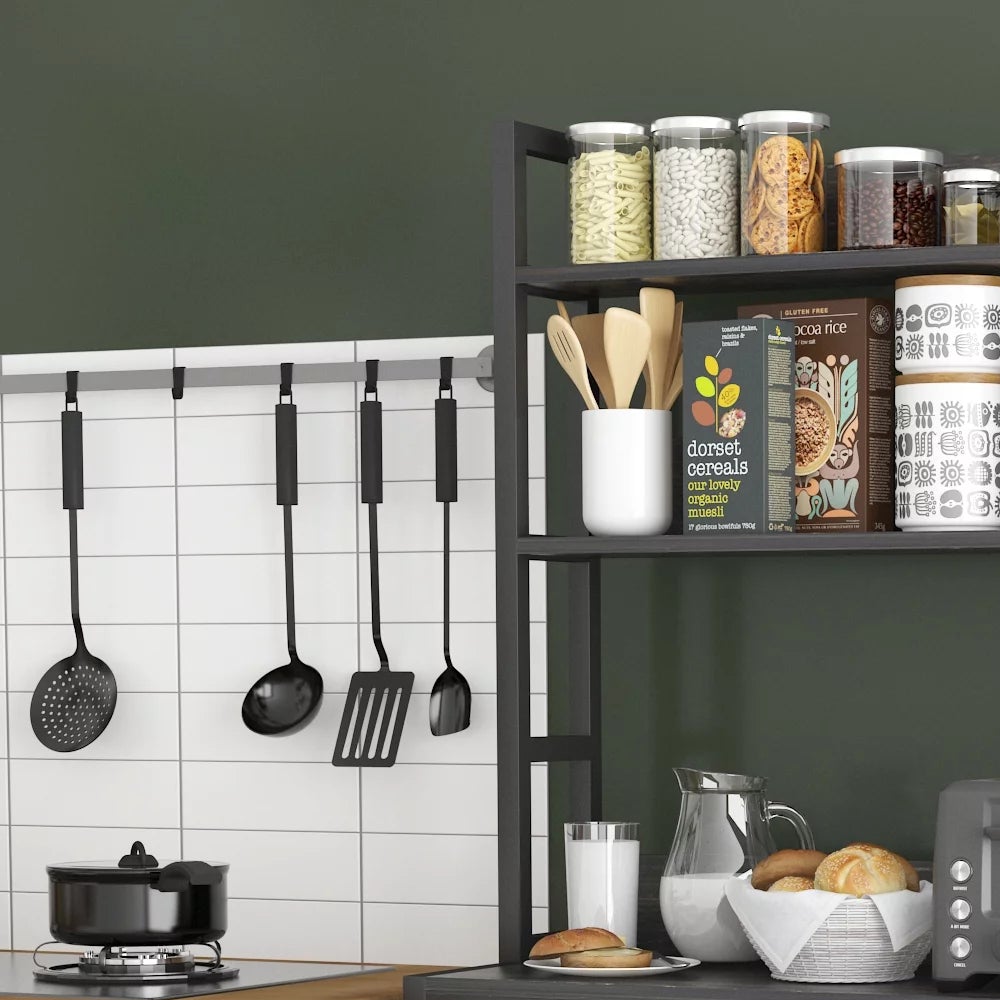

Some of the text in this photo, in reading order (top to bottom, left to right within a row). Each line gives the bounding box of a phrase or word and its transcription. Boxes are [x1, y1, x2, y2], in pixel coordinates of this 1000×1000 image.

[785, 307, 829, 316] GLUTEN FREE
[794, 320, 847, 336] ocoa rice
[687, 439, 742, 457] dorset
[687, 458, 749, 476] cereals
[687, 478, 741, 492] our lovely
[687, 492, 729, 506] organic
[687, 506, 725, 518] muesli
